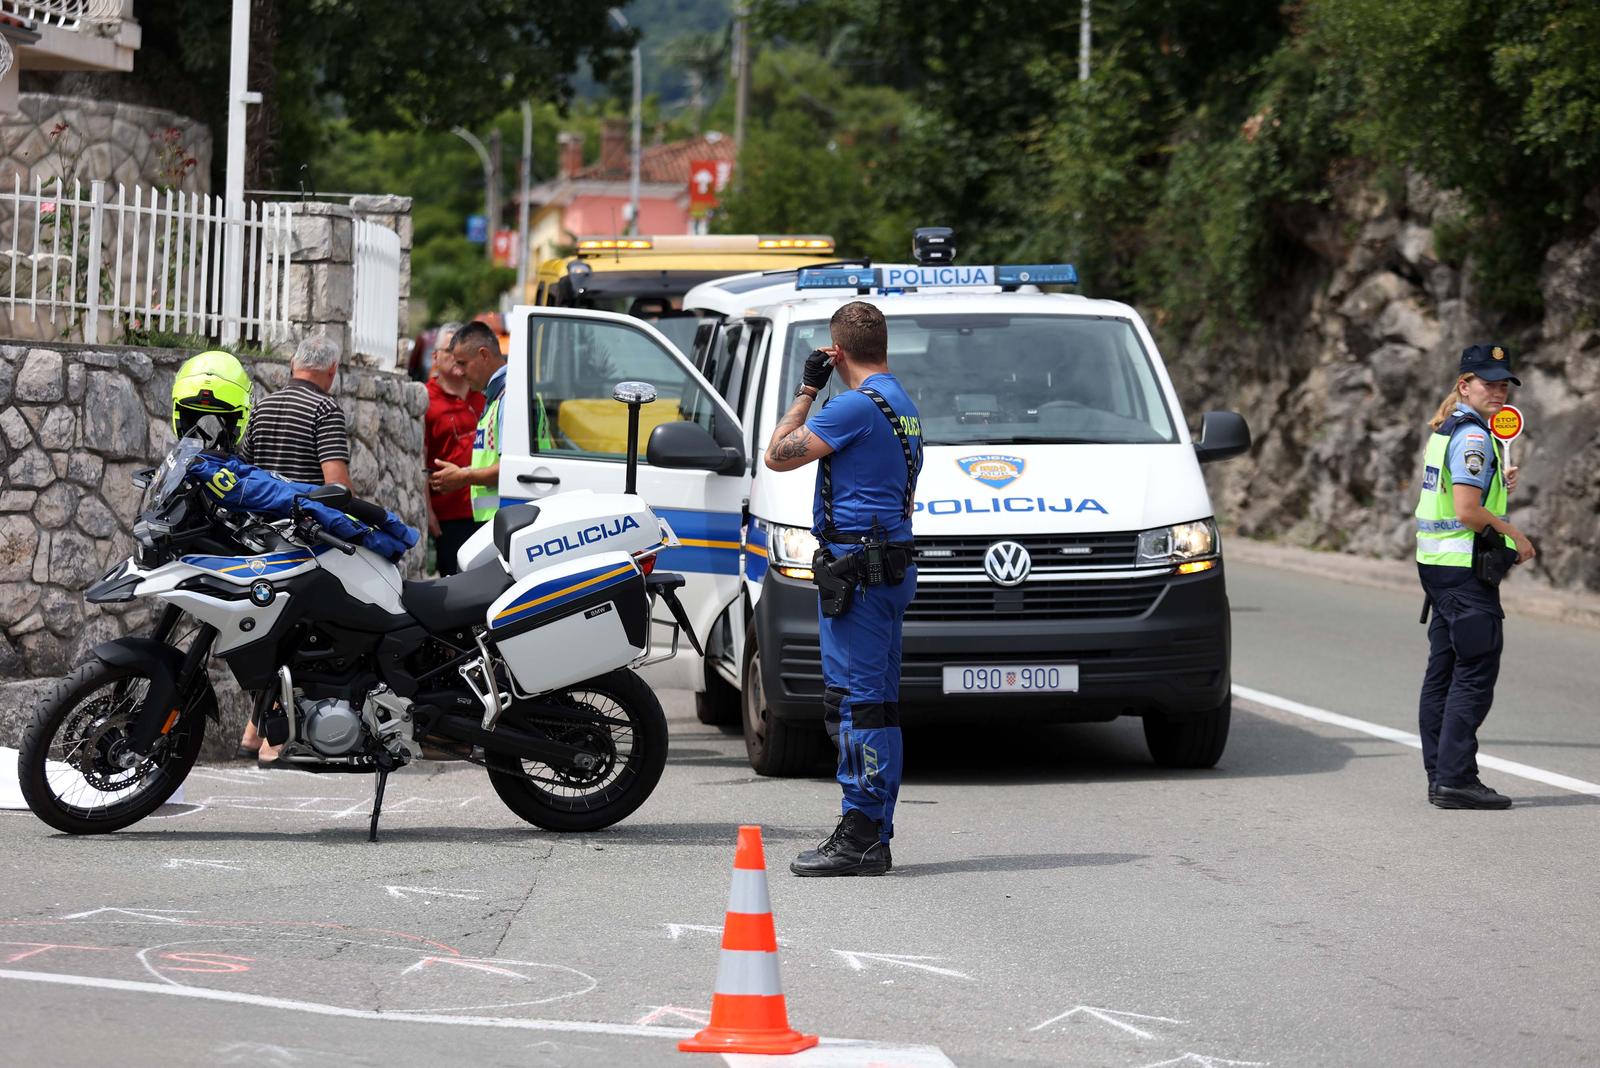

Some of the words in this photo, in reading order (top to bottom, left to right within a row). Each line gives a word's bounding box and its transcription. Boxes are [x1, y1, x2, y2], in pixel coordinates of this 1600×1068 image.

[889, 268, 988, 286] POLICIJA
[526, 515, 640, 562] POLICIJA
[963, 669, 1001, 689] 090
[1020, 668, 1060, 689] 900
